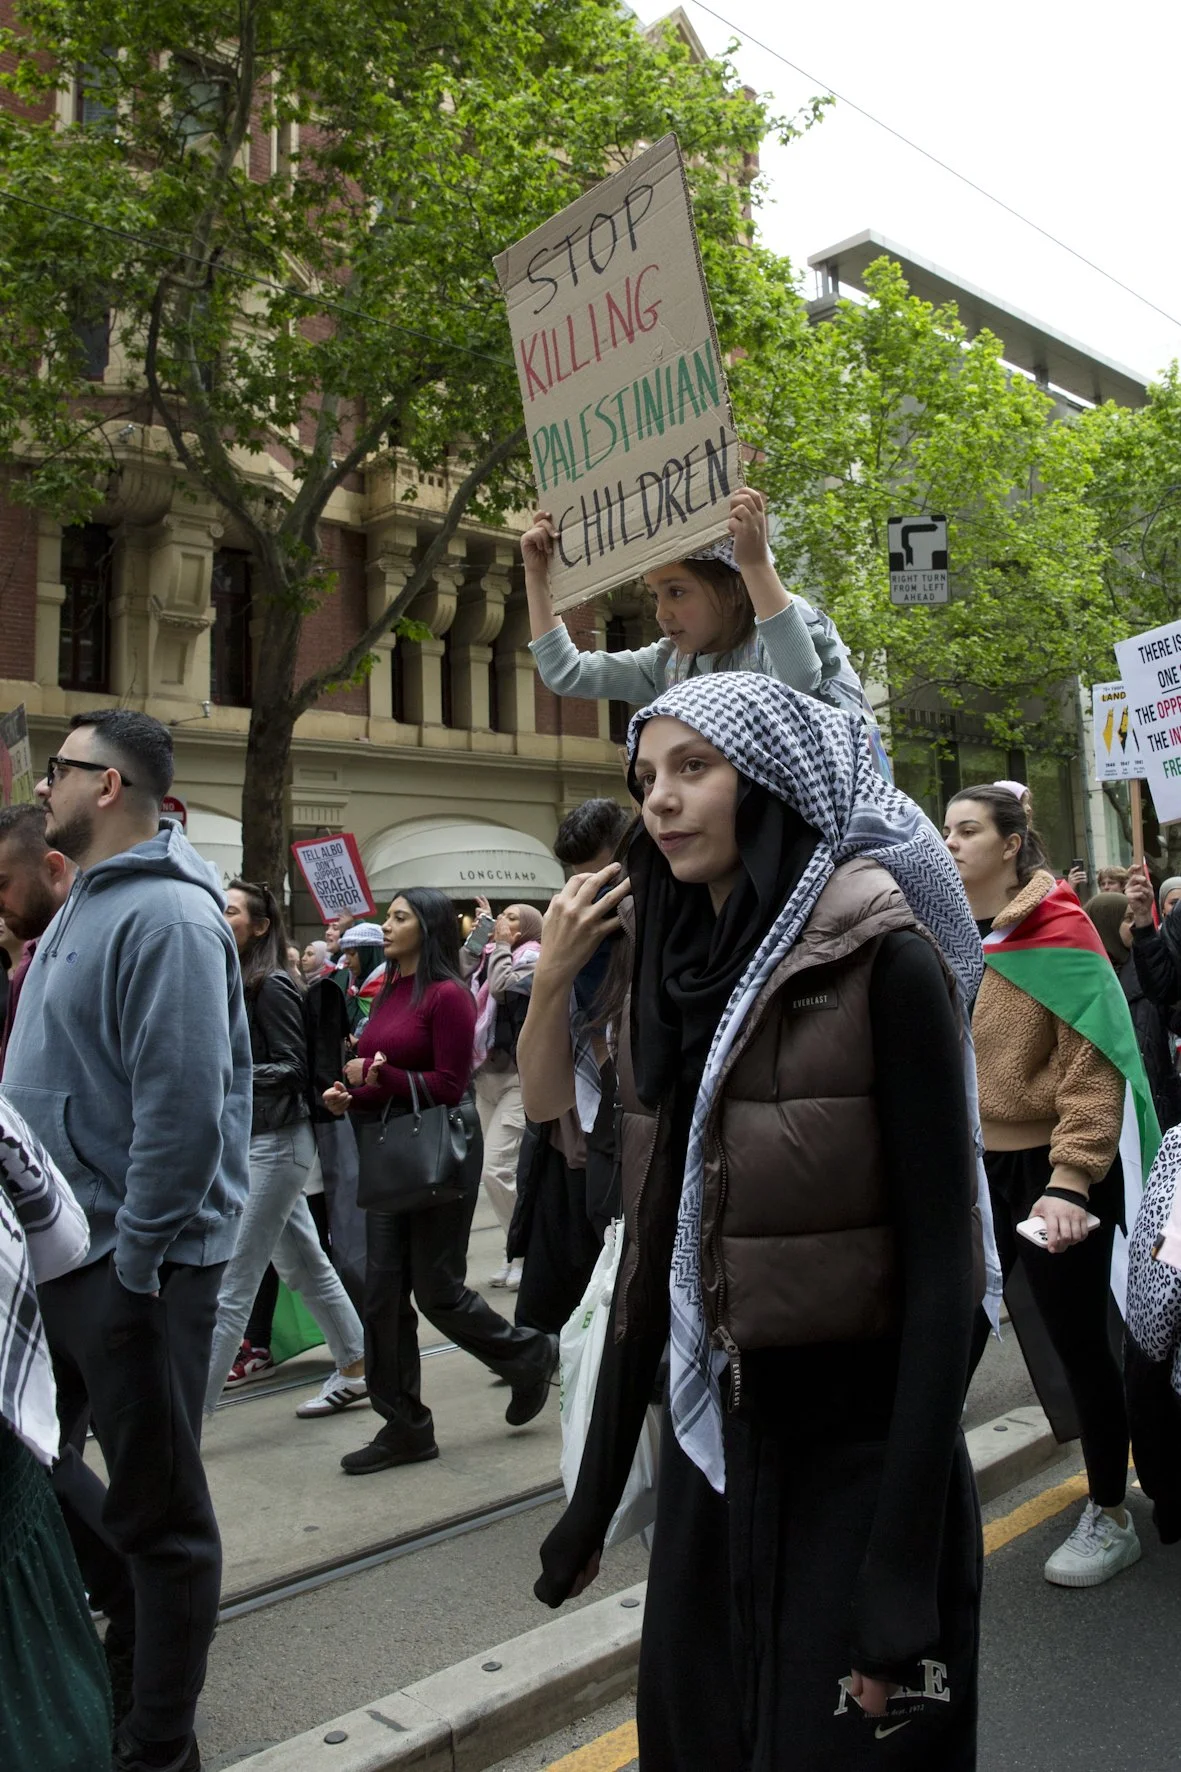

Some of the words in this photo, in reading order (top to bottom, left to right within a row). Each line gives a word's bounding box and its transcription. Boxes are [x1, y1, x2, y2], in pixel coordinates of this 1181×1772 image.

[527, 184, 653, 314] STOP
[520, 264, 662, 401] KILLING
[532, 339, 721, 491] PALESTINIAN
[558, 425, 731, 568] CHILDREN
[892, 574, 918, 583] RIGHT
[922, 574, 946, 582] TURN
[893, 584, 917, 592] FROM
[923, 583, 945, 591] LEFT
[904, 593, 935, 601] AHEAD
[1138, 637, 1171, 664] THERE
[1157, 666, 1180, 688] ONE
[1101, 691, 1127, 702] LAND
[1135, 704, 1157, 726] THE
[1147, 730, 1170, 752] THE
[162, 803, 175, 811] NO
[302, 849, 321, 861] TELL
[321, 843, 343, 858] ALBO
[314, 866, 345, 881] SUPPORT
[315, 859, 337, 871] DON'T
[313, 874, 356, 895] ISRAELI
[459, 870, 536, 881] LONGCHAMP
[319, 889, 362, 909] TERROR
[793, 995, 828, 1009] EVERLAST
[732, 1363, 741, 1406] EVERLAST
[833, 1658, 950, 1716] NE
